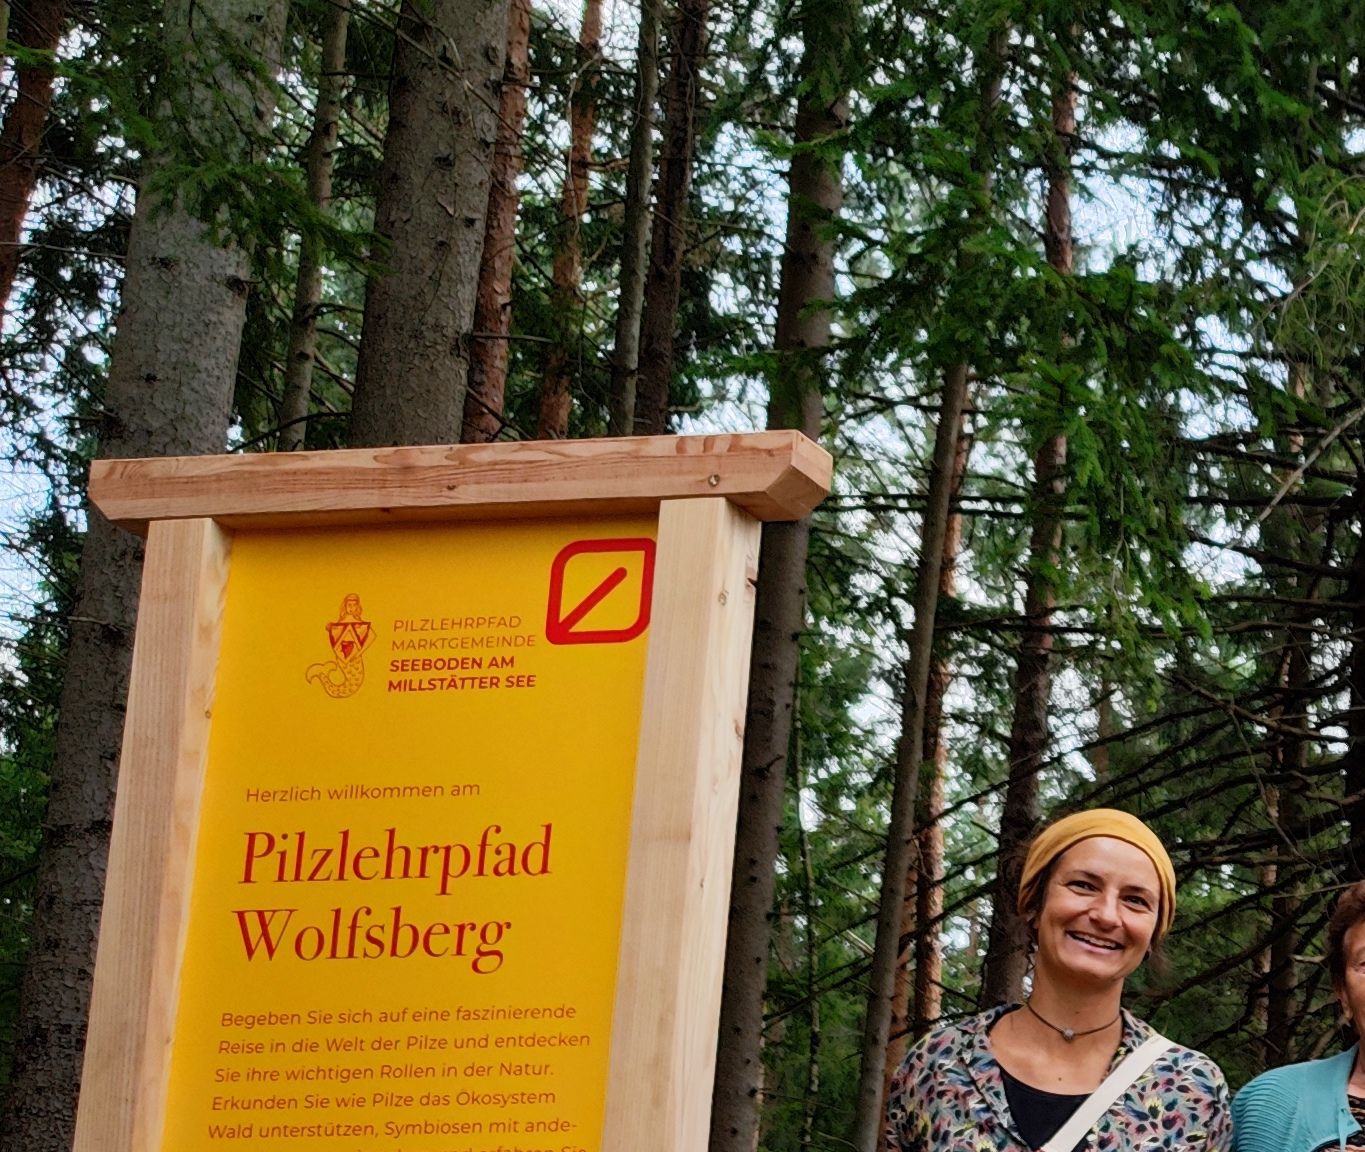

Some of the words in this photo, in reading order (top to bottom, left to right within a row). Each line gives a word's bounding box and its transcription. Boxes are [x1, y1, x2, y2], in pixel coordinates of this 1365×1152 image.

[393, 615, 522, 633] PILZLEHRPFAD
[391, 634, 537, 652] MARKTGEMEINDE
[389, 656, 483, 673] SEEBODEN
[487, 655, 515, 669] AM
[387, 674, 501, 693] MILLSTÄTTER
[504, 674, 537, 689] SEE
[246, 785, 322, 803] Herzlich
[327, 783, 445, 801] willkommen
[450, 783, 481, 797] am
[238, 822, 553, 897] Pilzlehrpfad
[231, 905, 512, 975] Wolfsberg
[220, 1010, 302, 1030] Begeben
[306, 1009, 334, 1025] Sie
[337, 1008, 373, 1025] sich
[378, 1007, 409, 1024] auf
[411, 1006, 451, 1023] eine
[455, 1003, 577, 1022] faszinierende
[217, 1040, 265, 1055] Reise
[269, 1038, 286, 1054] in
[291, 1037, 321, 1053] die
[325, 1036, 366, 1053] Welt
[370, 1035, 401, 1052] der
[406, 1034, 449, 1051] Pilze
[453, 1033, 490, 1050] und
[494, 1031, 591, 1049] entdecken
[214, 1067, 242, 1083] Sie
[245, 1066, 281, 1082] ihre
[284, 1064, 374, 1084] wichtigen
[379, 1063, 436, 1079] Rollen
[441, 1062, 458, 1078] in
[462, 1061, 494, 1078] der
[498, 1061, 554, 1077] Natur.
[211, 1094, 298, 1111] Erkunden
[303, 1093, 331, 1110] Sie
[335, 1092, 367, 1109] wie
[372, 1091, 415, 1108] Pilze
[418, 1091, 451, 1107] das
[455, 1088, 556, 1109] Ökosystem
[208, 1123, 254, 1140] Wald
[258, 1121, 379, 1139] unterstützen,
[383, 1119, 483, 1140] Symbiosen
[488, 1117, 520, 1134] mit
[524, 1117, 577, 1133] ande-
